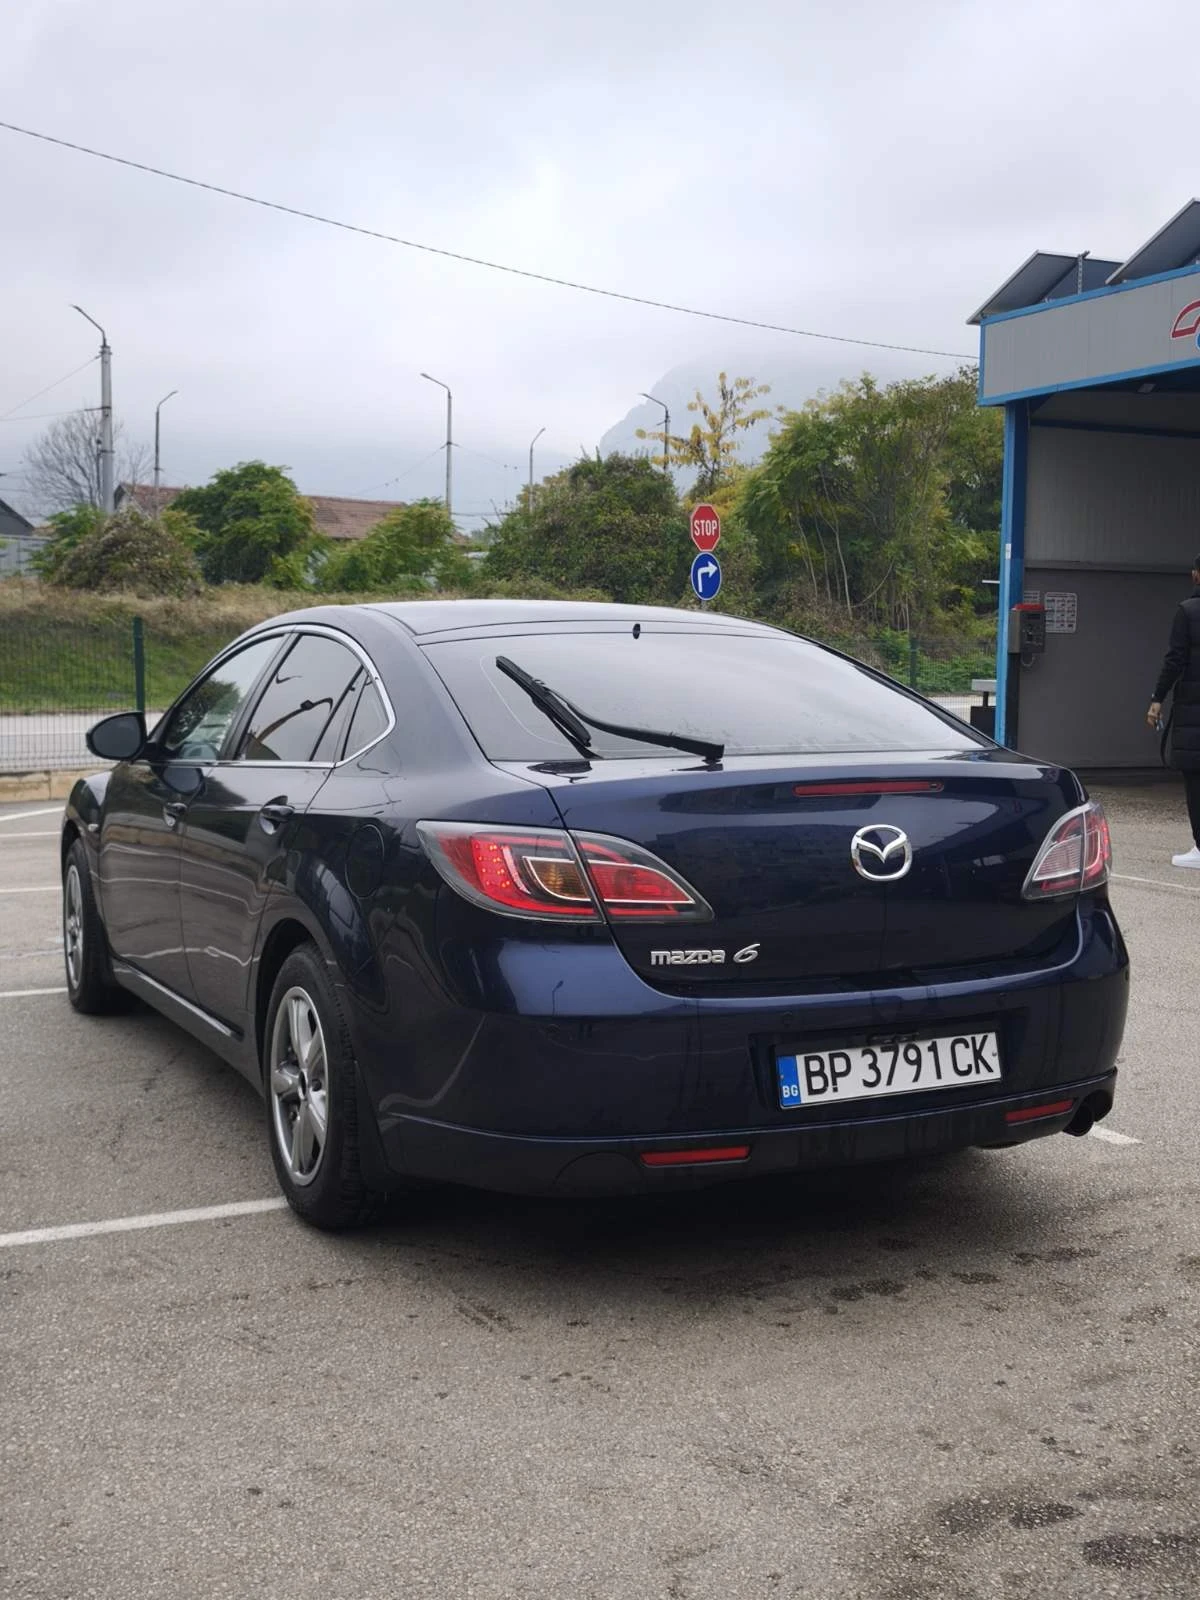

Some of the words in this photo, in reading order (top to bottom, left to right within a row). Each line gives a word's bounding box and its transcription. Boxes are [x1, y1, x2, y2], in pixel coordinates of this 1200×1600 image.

[694, 519, 718, 537] STOP
[650, 949, 726, 966] mazda
[732, 943, 761, 964] 6
[803, 1051, 852, 1096] BP
[860, 1040, 943, 1089] 3791
[950, 1034, 994, 1078] CK
[782, 1084, 799, 1099] BG
